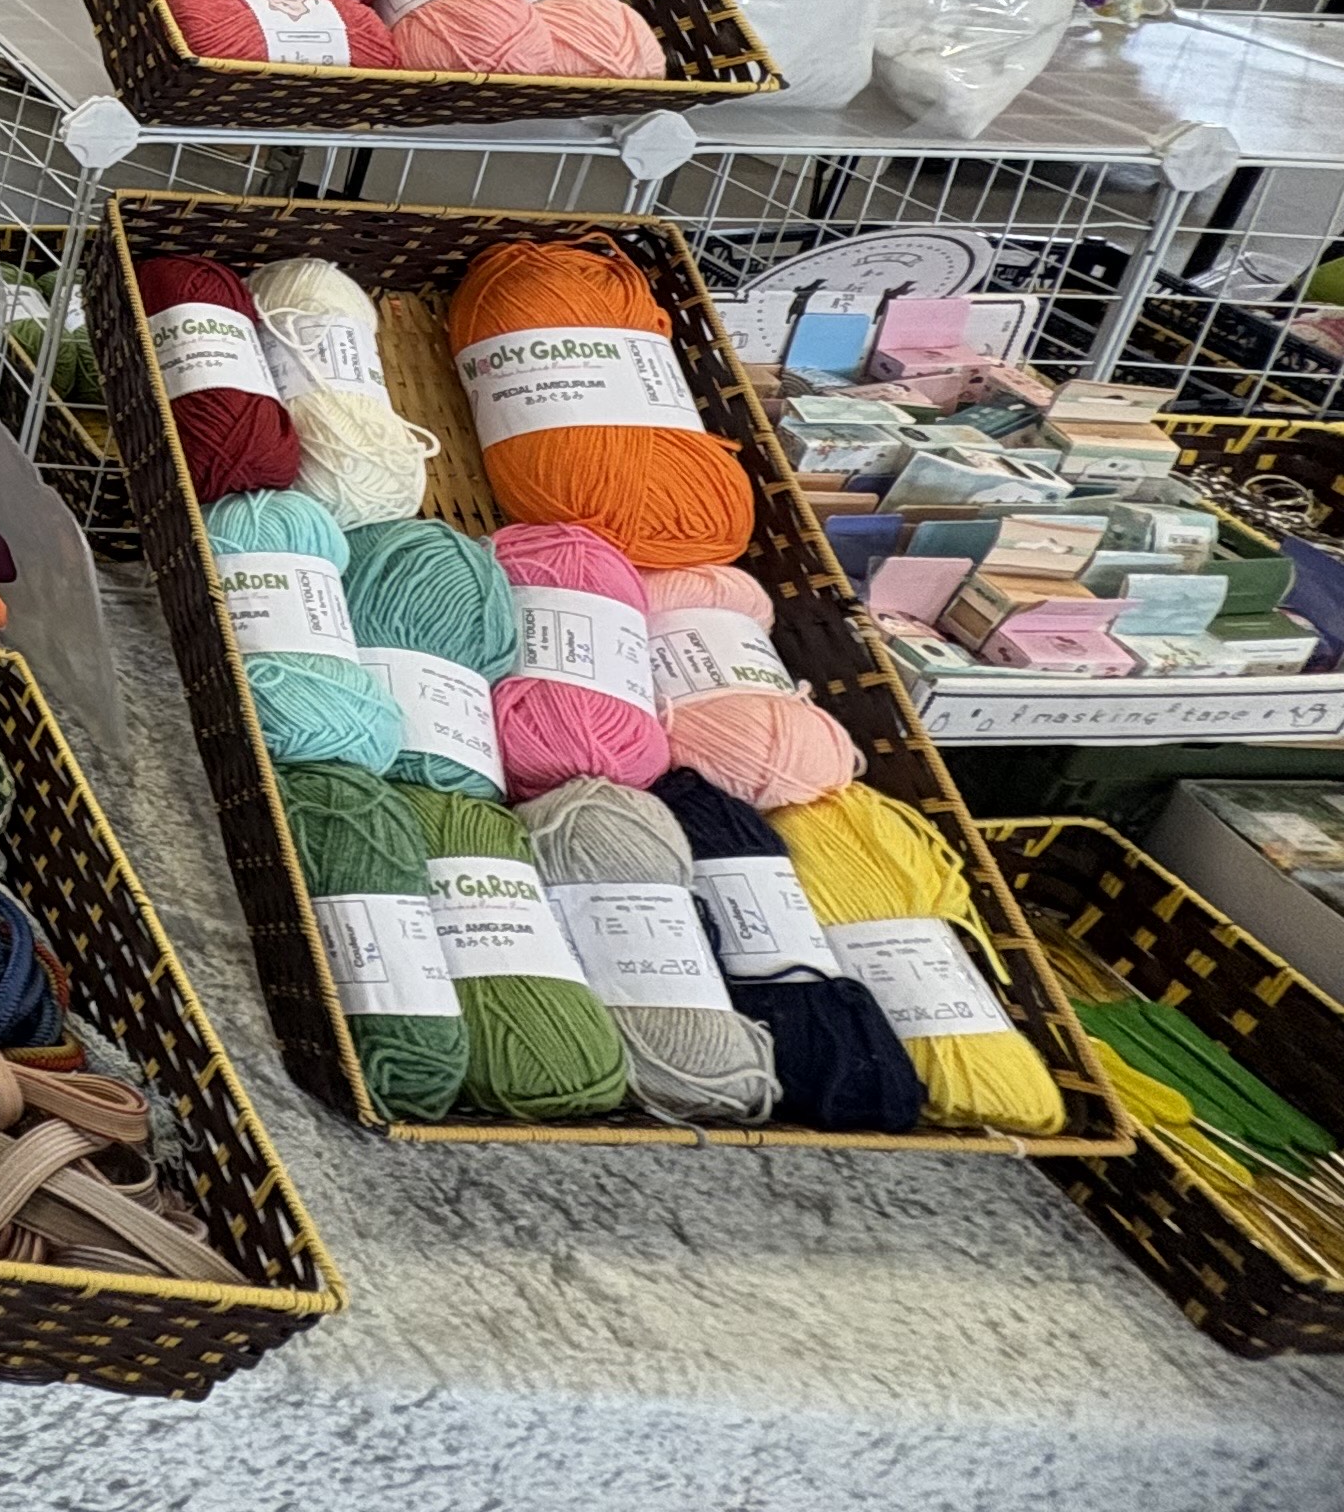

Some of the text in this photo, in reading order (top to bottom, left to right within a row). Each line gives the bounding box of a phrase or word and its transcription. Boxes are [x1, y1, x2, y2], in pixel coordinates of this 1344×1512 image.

[181, 318, 247, 341] GARDEN
[530, 339, 622, 361] GARDEN
[492, 379, 606, 402] SPECIAL AMIGURUMI
[221, 571, 290, 593] ARDEN
[525, 609, 538, 665] SOFT TOUCH
[565, 629, 576, 664] Couleur
[1031, 705, 1249, 727] masking tape
[455, 874, 542, 903] GARDEN
[726, 896, 753, 940] Couleur
[345, 923, 365, 968] Couleur
